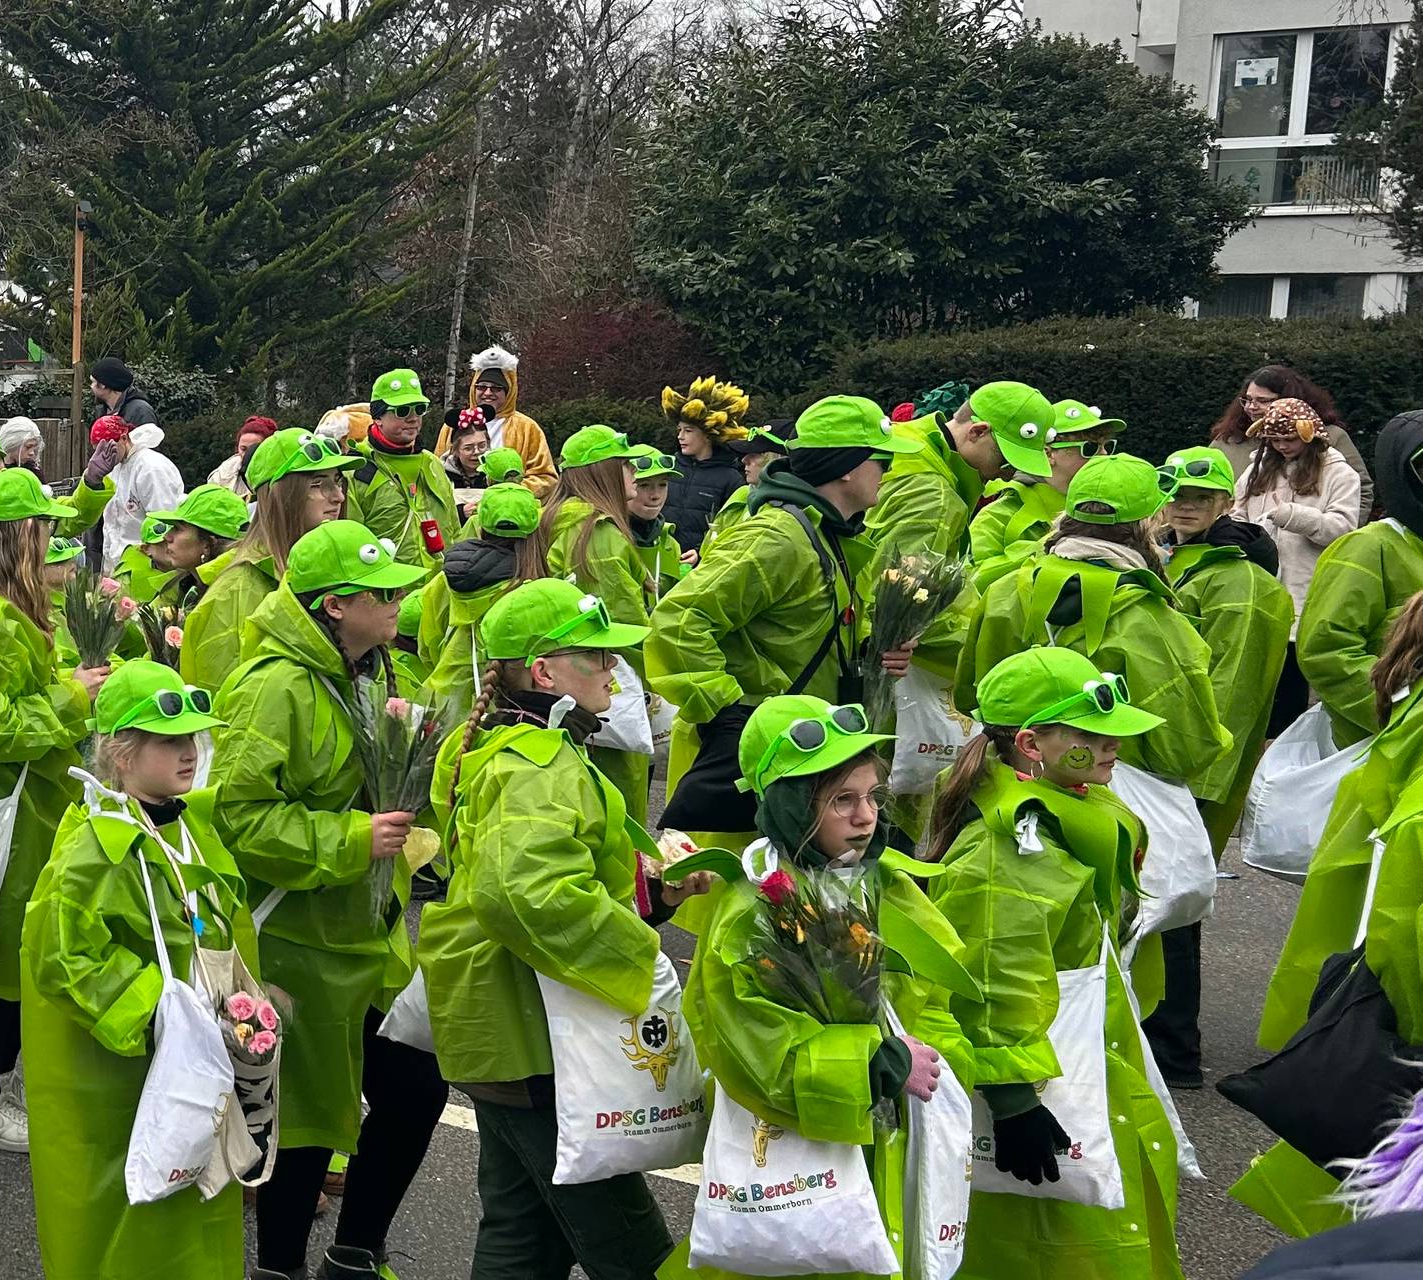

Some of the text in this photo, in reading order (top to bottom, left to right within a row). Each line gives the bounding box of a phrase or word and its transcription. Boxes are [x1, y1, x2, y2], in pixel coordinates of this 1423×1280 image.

[918, 743, 954, 756] DPSG
[596, 1095, 705, 1129] DPSG Bensberg
[623, 1127, 651, 1136] Stamm
[708, 1169, 838, 1203] DPSG Bensberg
[730, 1198, 813, 1213] Stamm Ommerborn
